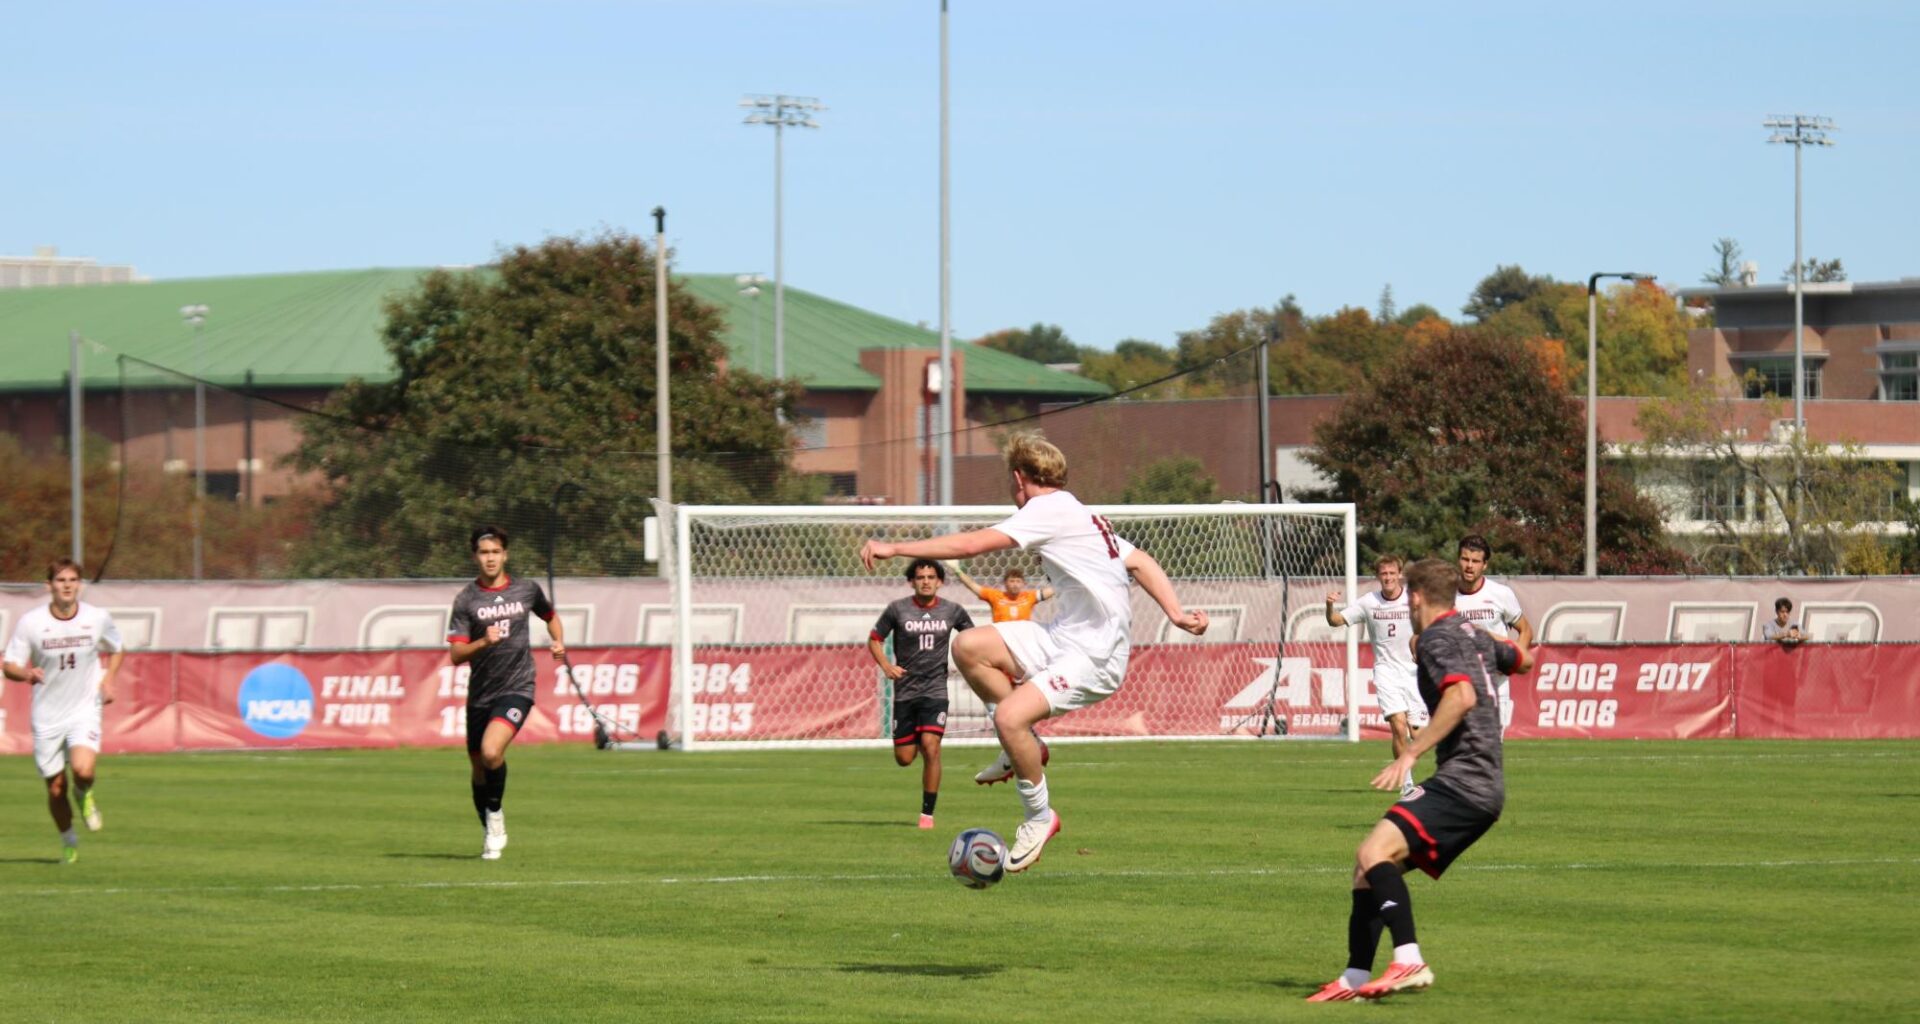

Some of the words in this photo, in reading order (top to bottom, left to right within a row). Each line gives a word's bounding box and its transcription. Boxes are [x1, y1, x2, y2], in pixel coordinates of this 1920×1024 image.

[477, 601, 524, 619] OMAHA
[905, 620, 948, 632] OMAHA
[1387, 623, 1396, 637] 2
[918, 634, 934, 650] 10
[59, 652, 76, 671] 14
[320, 675, 405, 698] FINAL
[553, 663, 641, 695] 1986
[691, 663, 752, 694] 984
[1536, 662, 1618, 691] 2002
[1636, 662, 1712, 691] 2017
[244, 699, 313, 721] NCAA
[322, 703, 391, 727] FOUR
[1537, 699, 1619, 728] 2008
